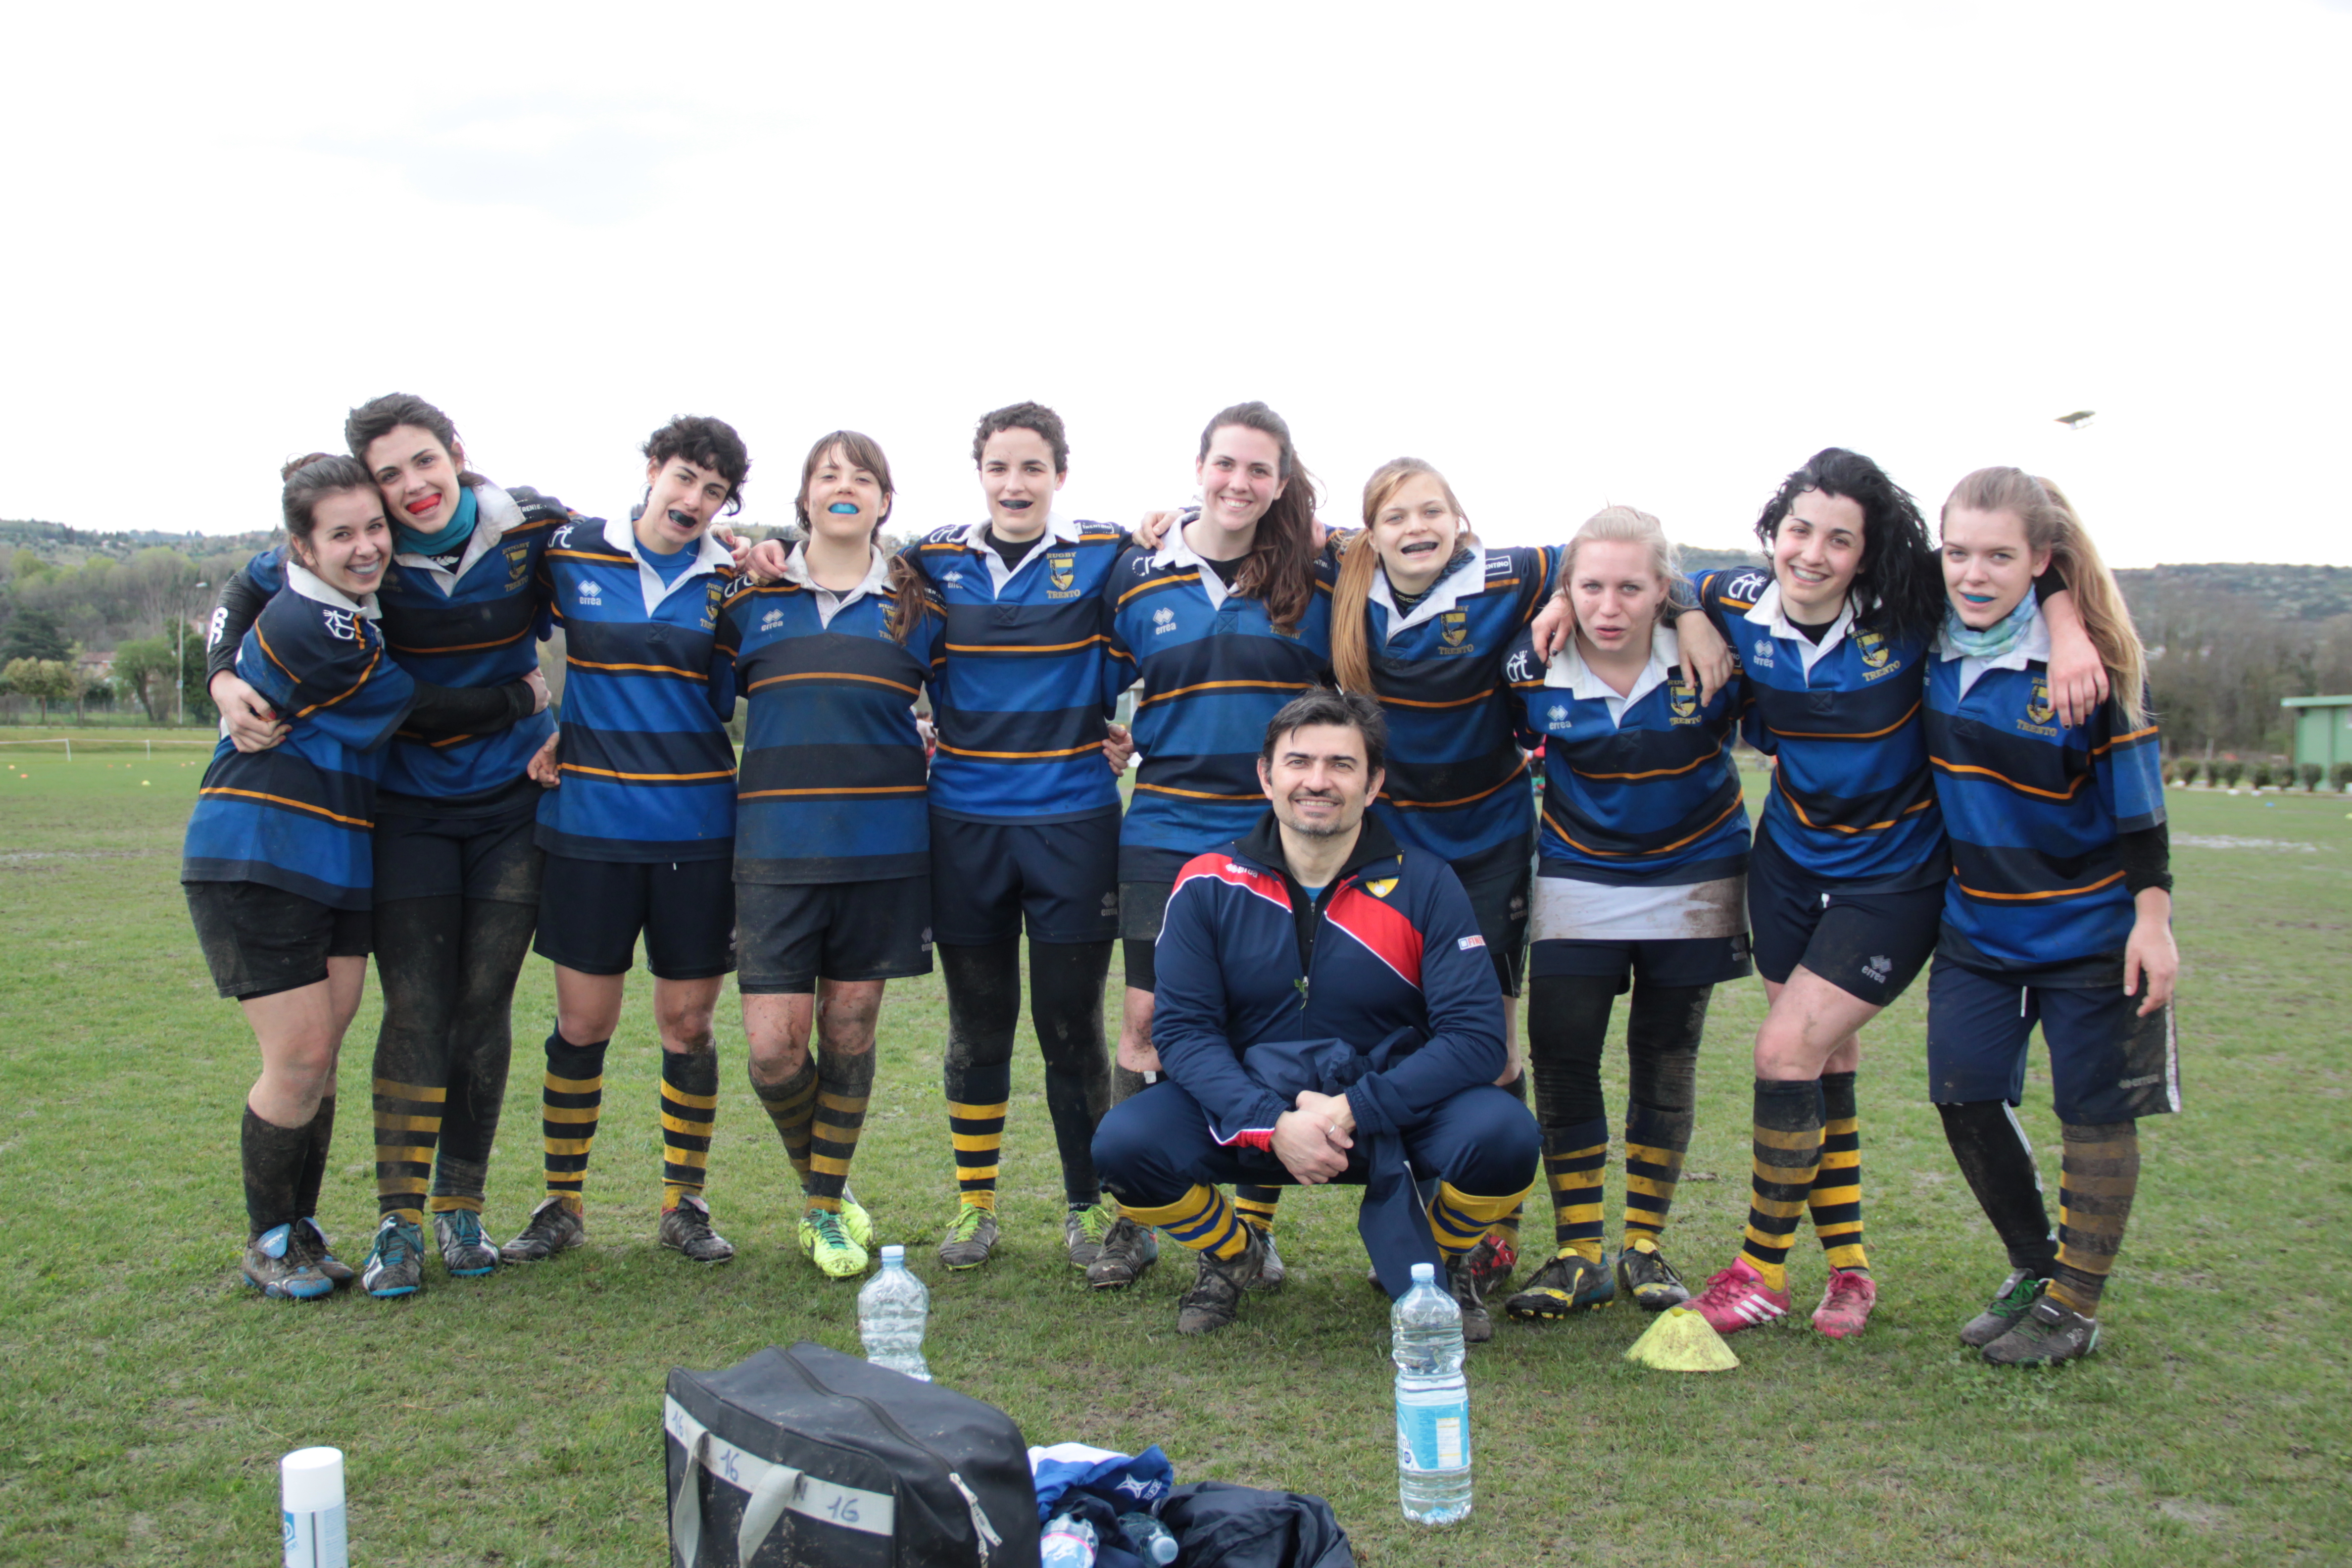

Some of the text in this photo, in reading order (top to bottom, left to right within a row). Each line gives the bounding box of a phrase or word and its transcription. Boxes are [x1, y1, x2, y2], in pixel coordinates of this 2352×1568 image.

[502, 541, 530, 555] RUGBY
[1485, 561, 1509, 570] ENTINO
[504, 575, 529, 592] TRENTO
[579, 596, 602, 605] errea
[1046, 589, 1080, 599] TRENTO
[761, 621, 784, 632] errea
[1156, 622, 1176, 635] errea
[1438, 644, 1474, 655] TRENTO
[1753, 656, 1774, 669] errea
[1862, 660, 1901, 682] TRENTO
[1549, 721, 1572, 730] errea
[1669, 715, 1702, 726] TRENTO
[2016, 719, 2058, 737] TRENTO
[1862, 965, 1886, 984] errea
[672, 1410, 684, 1438] 16
[720, 1449, 739, 1482] 16
[827, 1496, 860, 1522] 16
